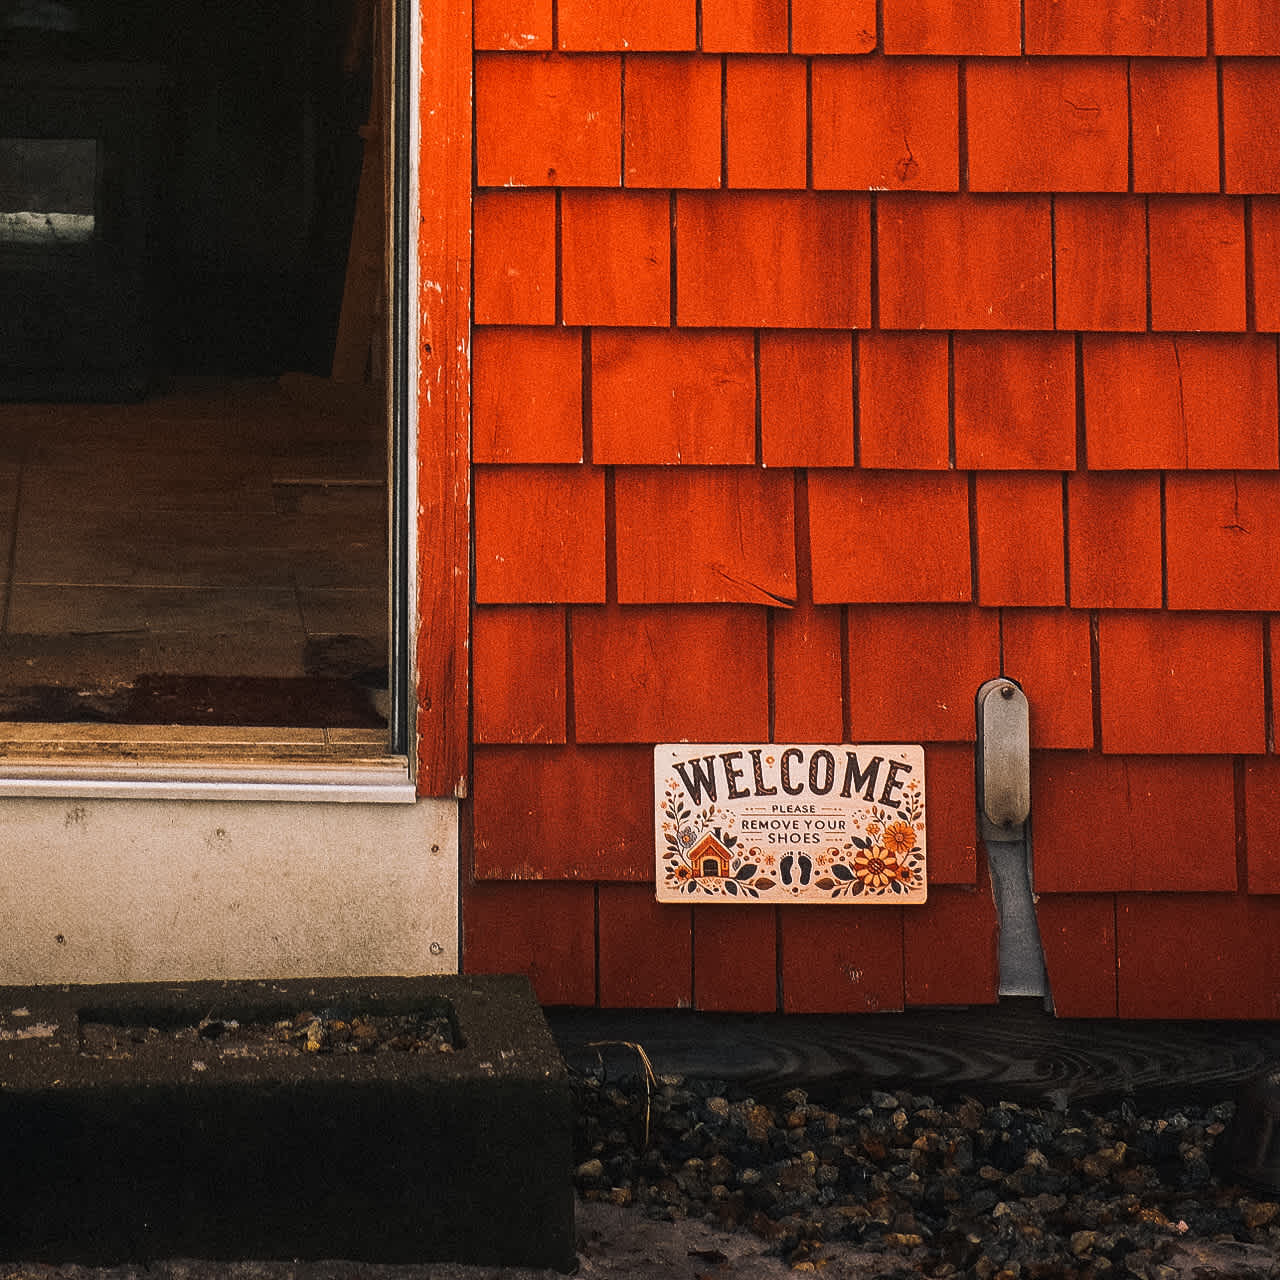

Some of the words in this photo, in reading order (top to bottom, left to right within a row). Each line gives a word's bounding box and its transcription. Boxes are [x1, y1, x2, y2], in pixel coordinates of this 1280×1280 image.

[672, 748, 913, 808] WELCOME
[771, 804, 816, 814] PLEASE
[741, 820, 800, 831] REMOVE
[803, 819, 846, 831] YOUR
[767, 832, 821, 844] SHOES
